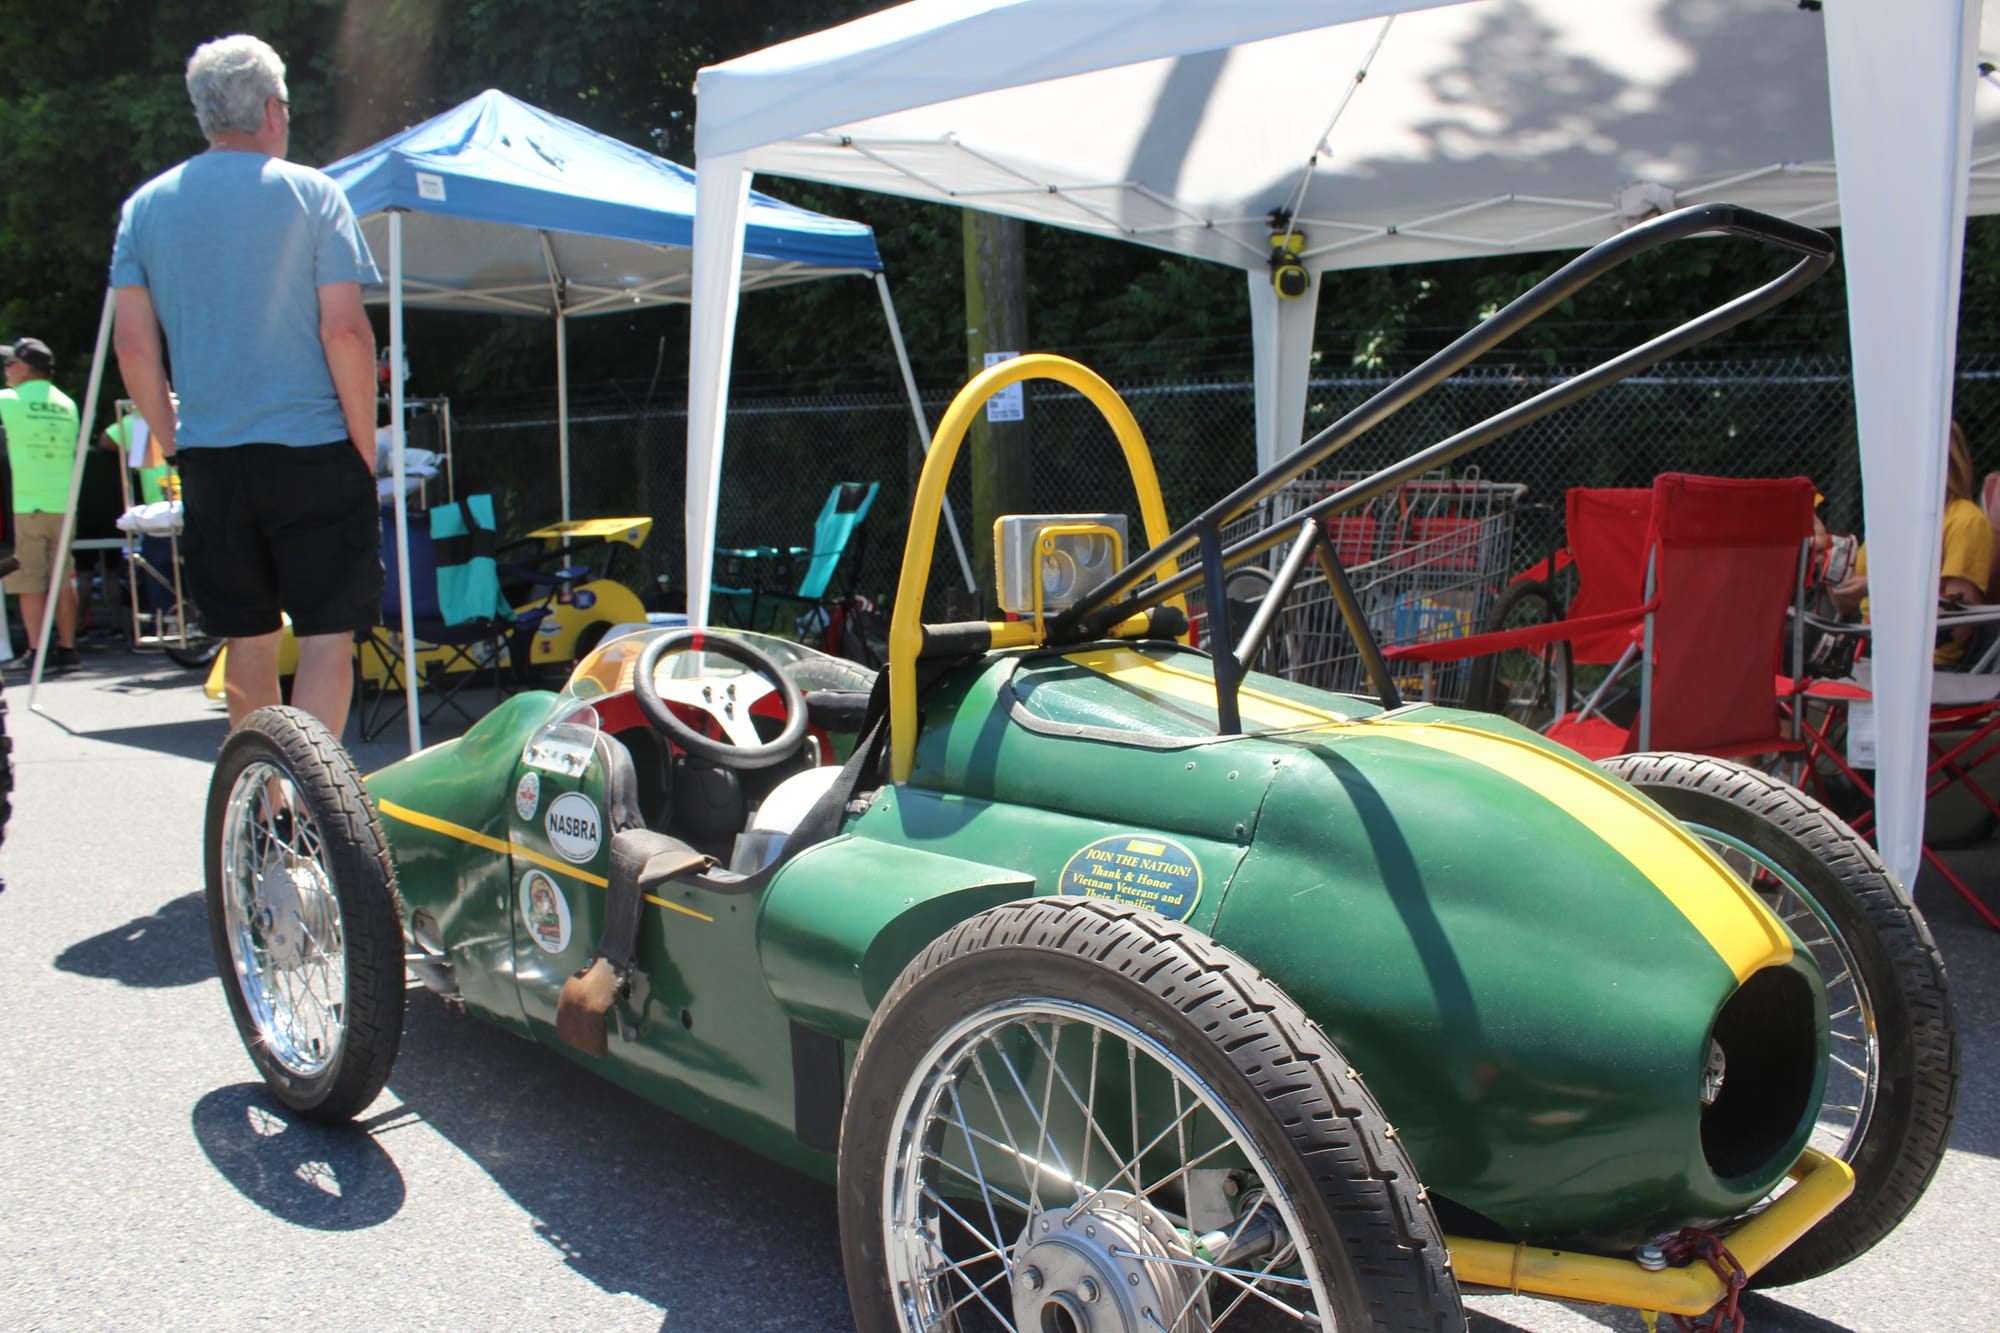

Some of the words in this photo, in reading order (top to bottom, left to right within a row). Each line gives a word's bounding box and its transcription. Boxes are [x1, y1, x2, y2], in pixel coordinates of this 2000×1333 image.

[550, 813, 597, 841] NASBRA
[1086, 849, 1114, 862] JOIN
[1116, 854, 1139, 867] THE
[1140, 859, 1192, 877] NATION!
[1091, 864, 1122, 880] Thank
[1124, 871, 1135, 883] &
[1136, 873, 1173, 890] Honor
[1072, 872, 1114, 891] Vietnam
[1116, 882, 1159, 900] Veterans
[1161, 894, 1184, 905] and
